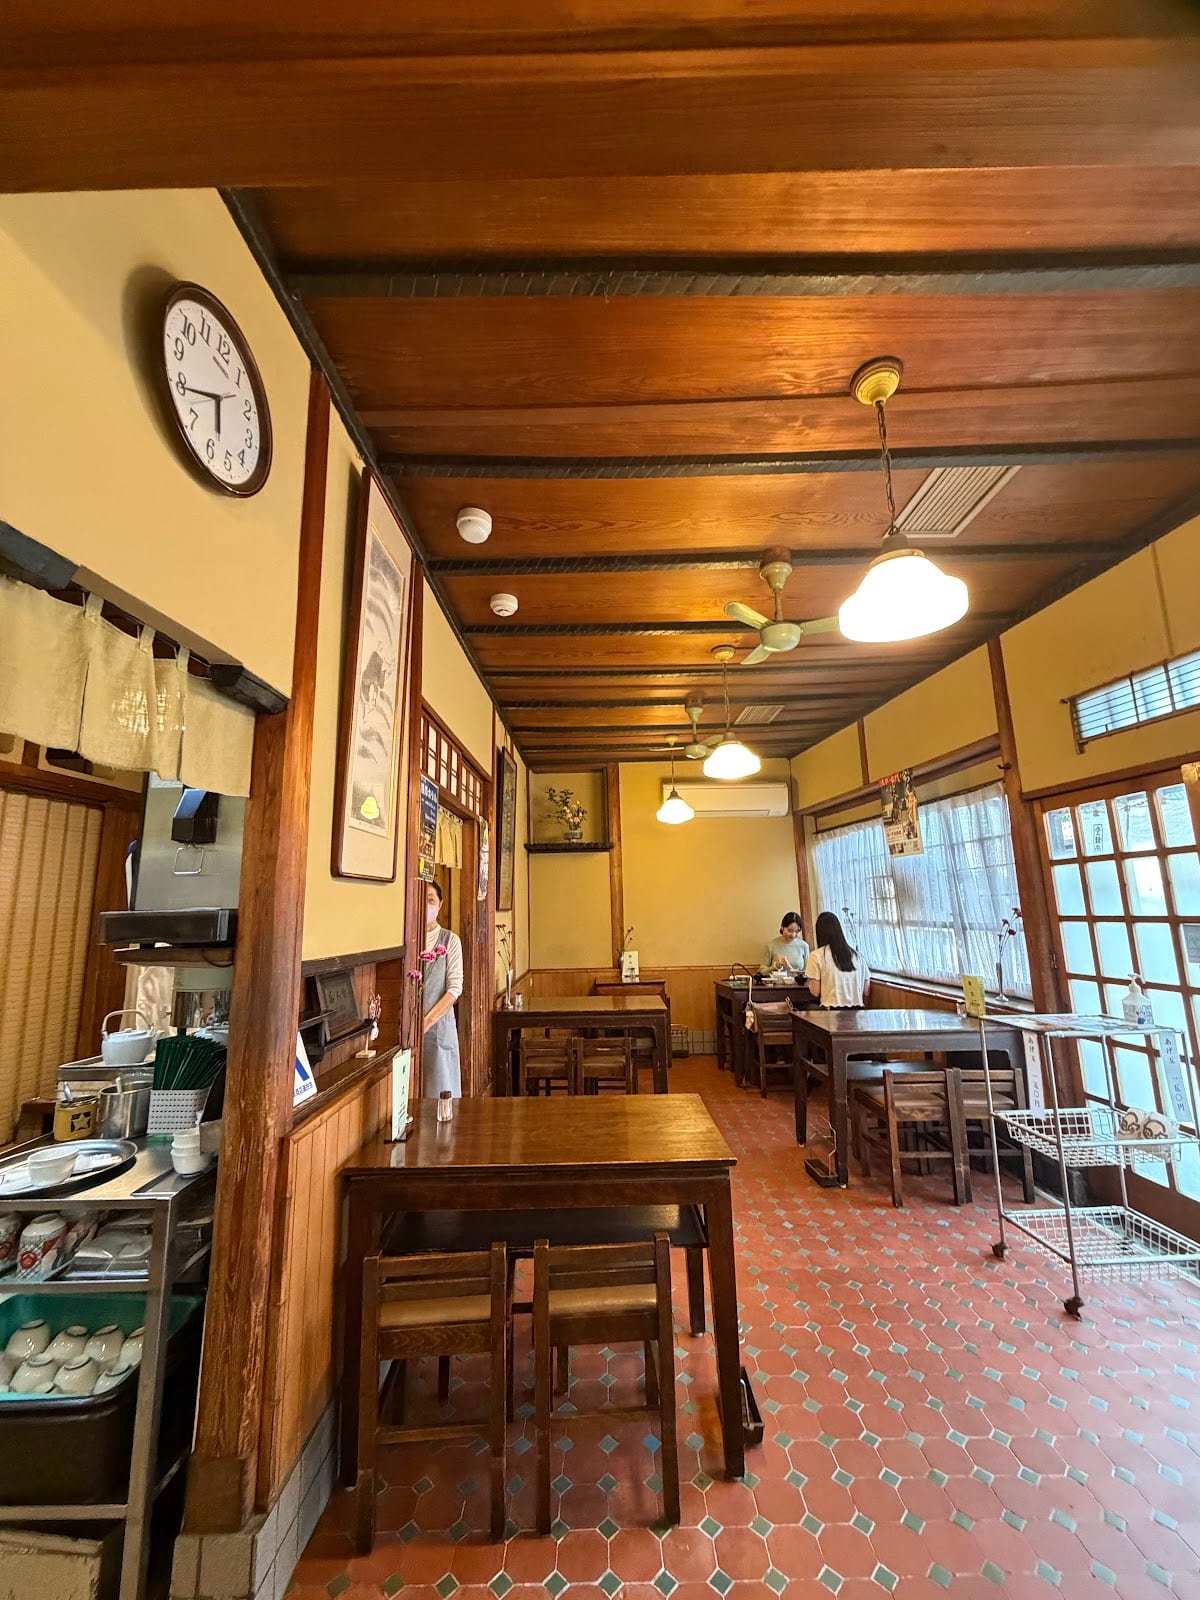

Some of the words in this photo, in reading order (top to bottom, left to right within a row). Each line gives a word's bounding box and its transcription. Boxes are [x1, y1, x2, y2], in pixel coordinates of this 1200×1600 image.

[179, 308, 196, 346] 10
[199, 309, 210, 347] 11
[174, 337, 185, 361] 9
[217, 333, 231, 365] 12
[176, 372, 187, 396] 8
[235, 367, 242, 389] 1
[189, 407, 199, 432] 7
[243, 399, 252, 421] 2
[206, 438, 215, 460] 6
[244, 428, 253, 449] 3
[223, 449, 233, 472] 5
[237, 449, 246, 468] 4
